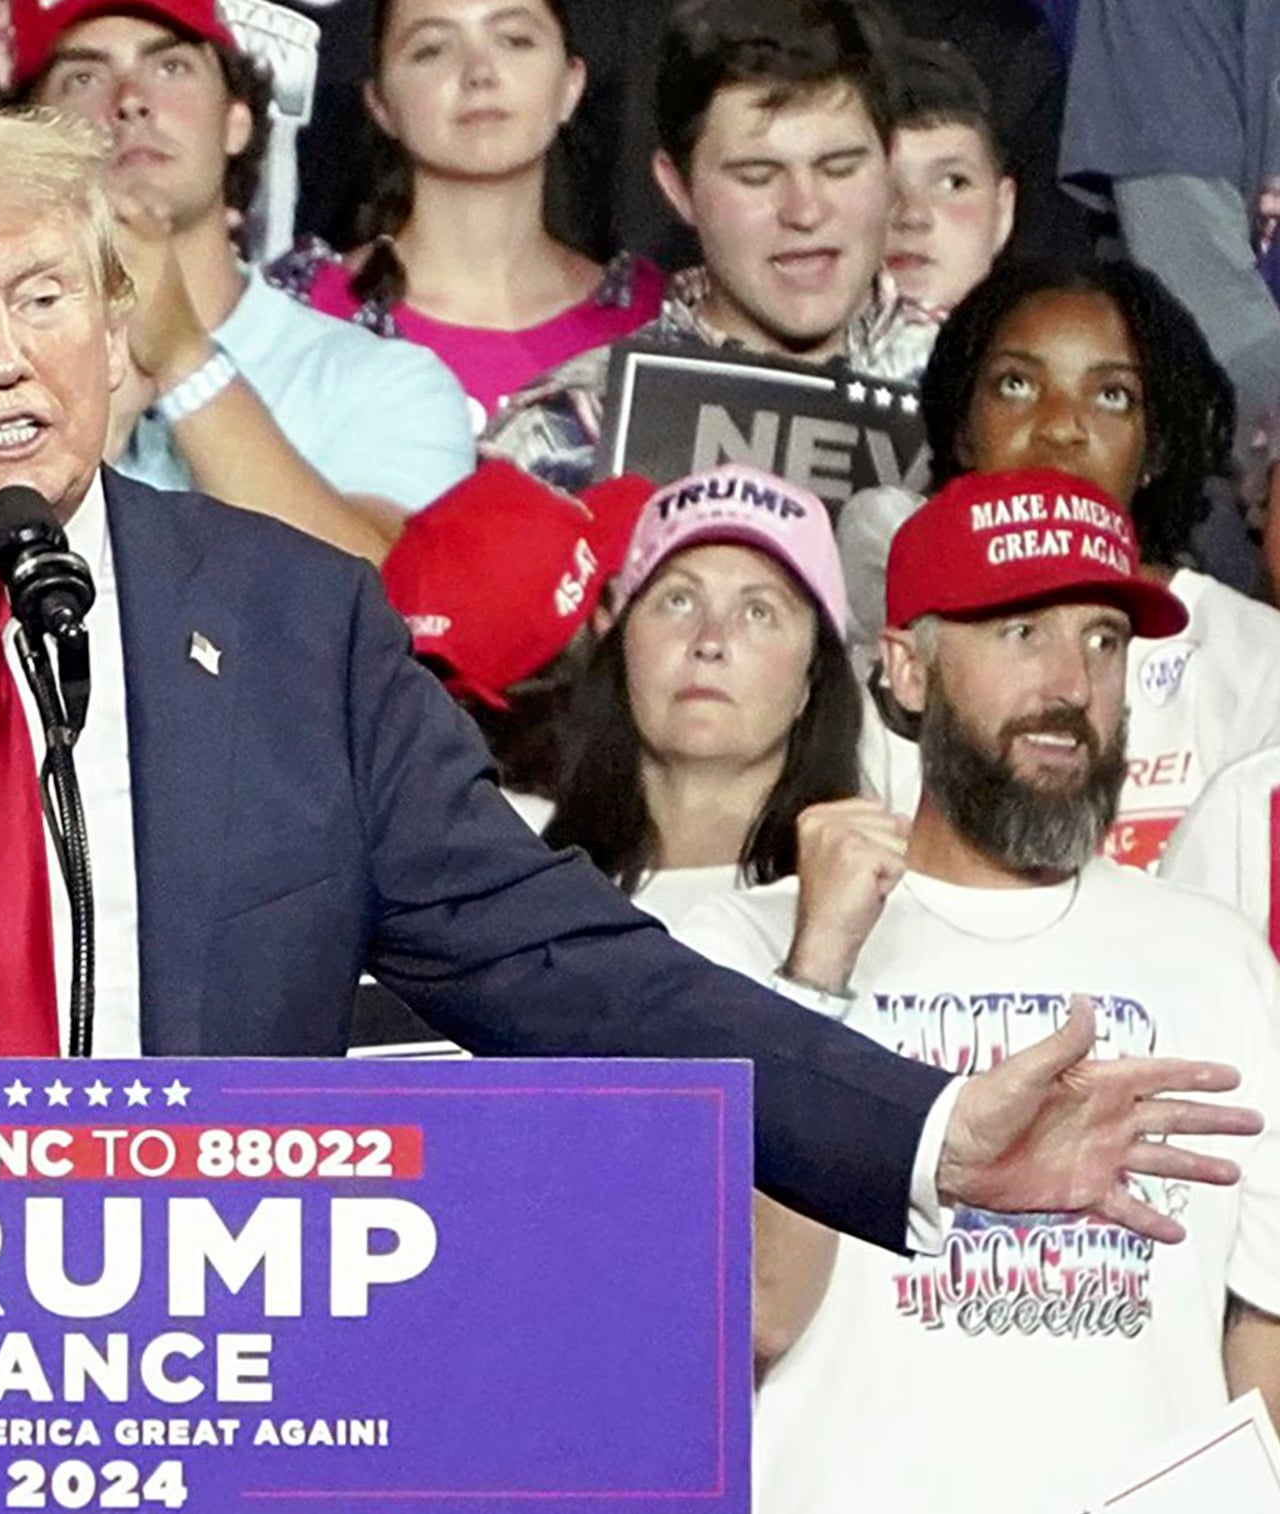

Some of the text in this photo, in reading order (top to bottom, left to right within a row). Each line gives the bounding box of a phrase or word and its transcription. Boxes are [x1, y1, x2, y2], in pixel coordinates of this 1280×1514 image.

[693, 403, 933, 500] NEV
[657, 478, 807, 520] TRUMP
[971, 494, 1048, 532] MAKE
[987, 530, 1073, 565] GREAT
[93, 1128, 177, 1177] TO
[195, 1128, 394, 1178] 88022
[114, 1417, 241, 1446] GREAT
[253, 1417, 390, 1446] AGAIN!
[5, 1459, 189, 1510] 2024
